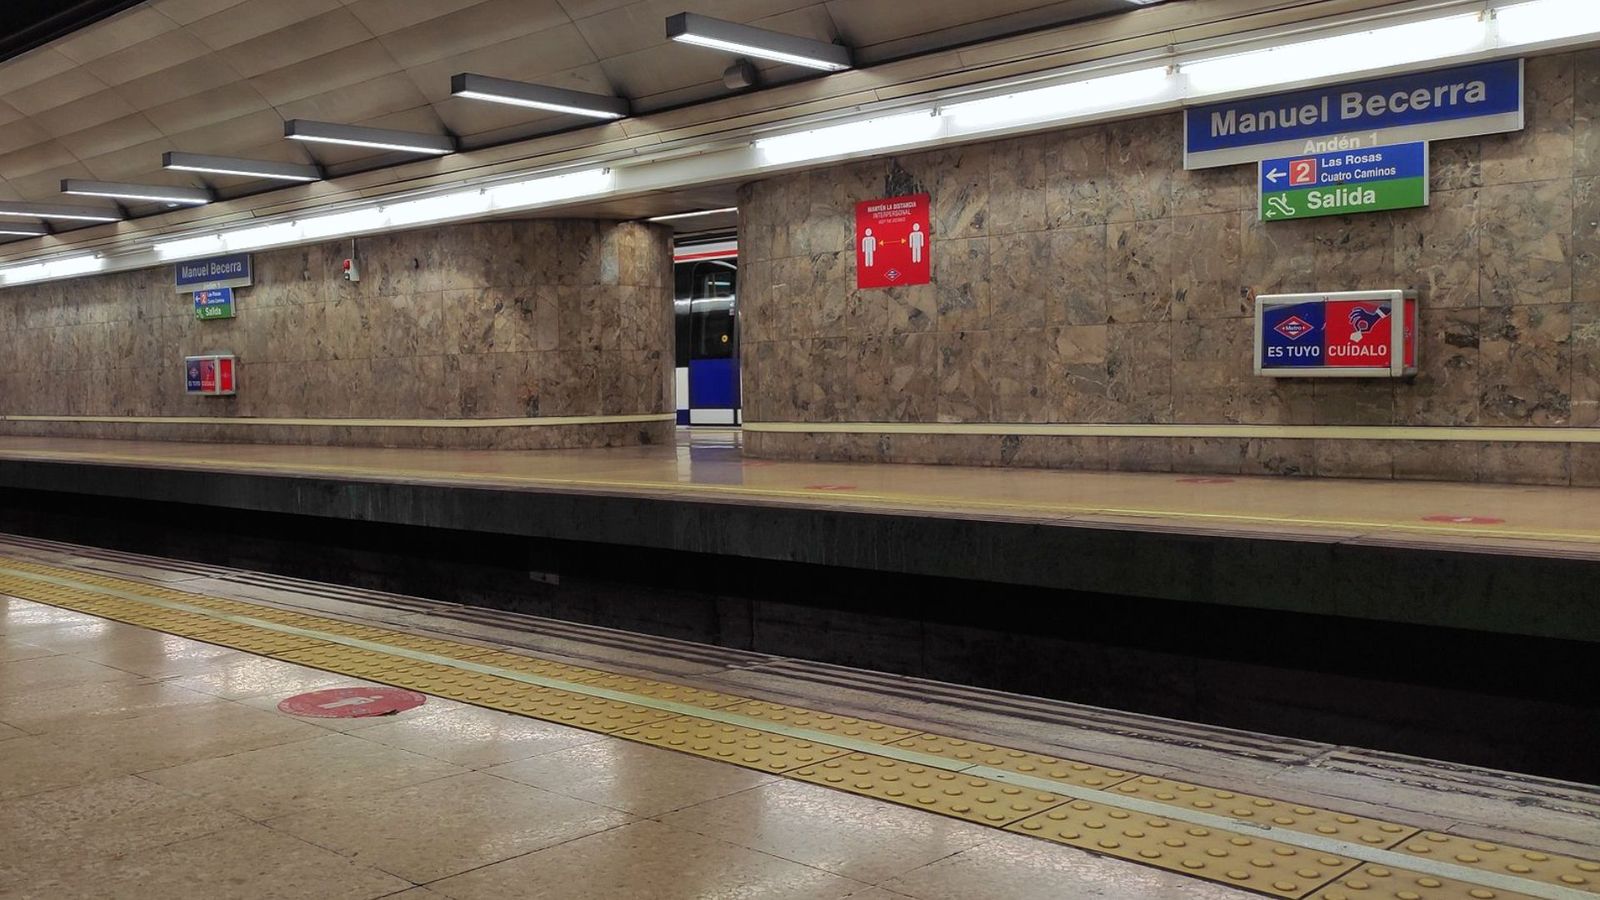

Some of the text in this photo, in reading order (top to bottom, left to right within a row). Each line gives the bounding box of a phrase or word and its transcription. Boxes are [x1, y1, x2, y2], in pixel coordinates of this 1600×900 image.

[1211, 80, 1486, 137] Manuel Becerra
[1303, 133, 1378, 154] Andén 1
[1321, 152, 1383, 168] Las Rosas
[1296, 162, 1310, 182] 2
[1321, 165, 1396, 183] Cuatro Caminos
[1306, 186, 1376, 210] Salida
[182, 261, 242, 279] Manuel Becerra
[205, 307, 221, 315] Salida
[1267, 342, 1387, 357] ES TUYO CUÍDALO
